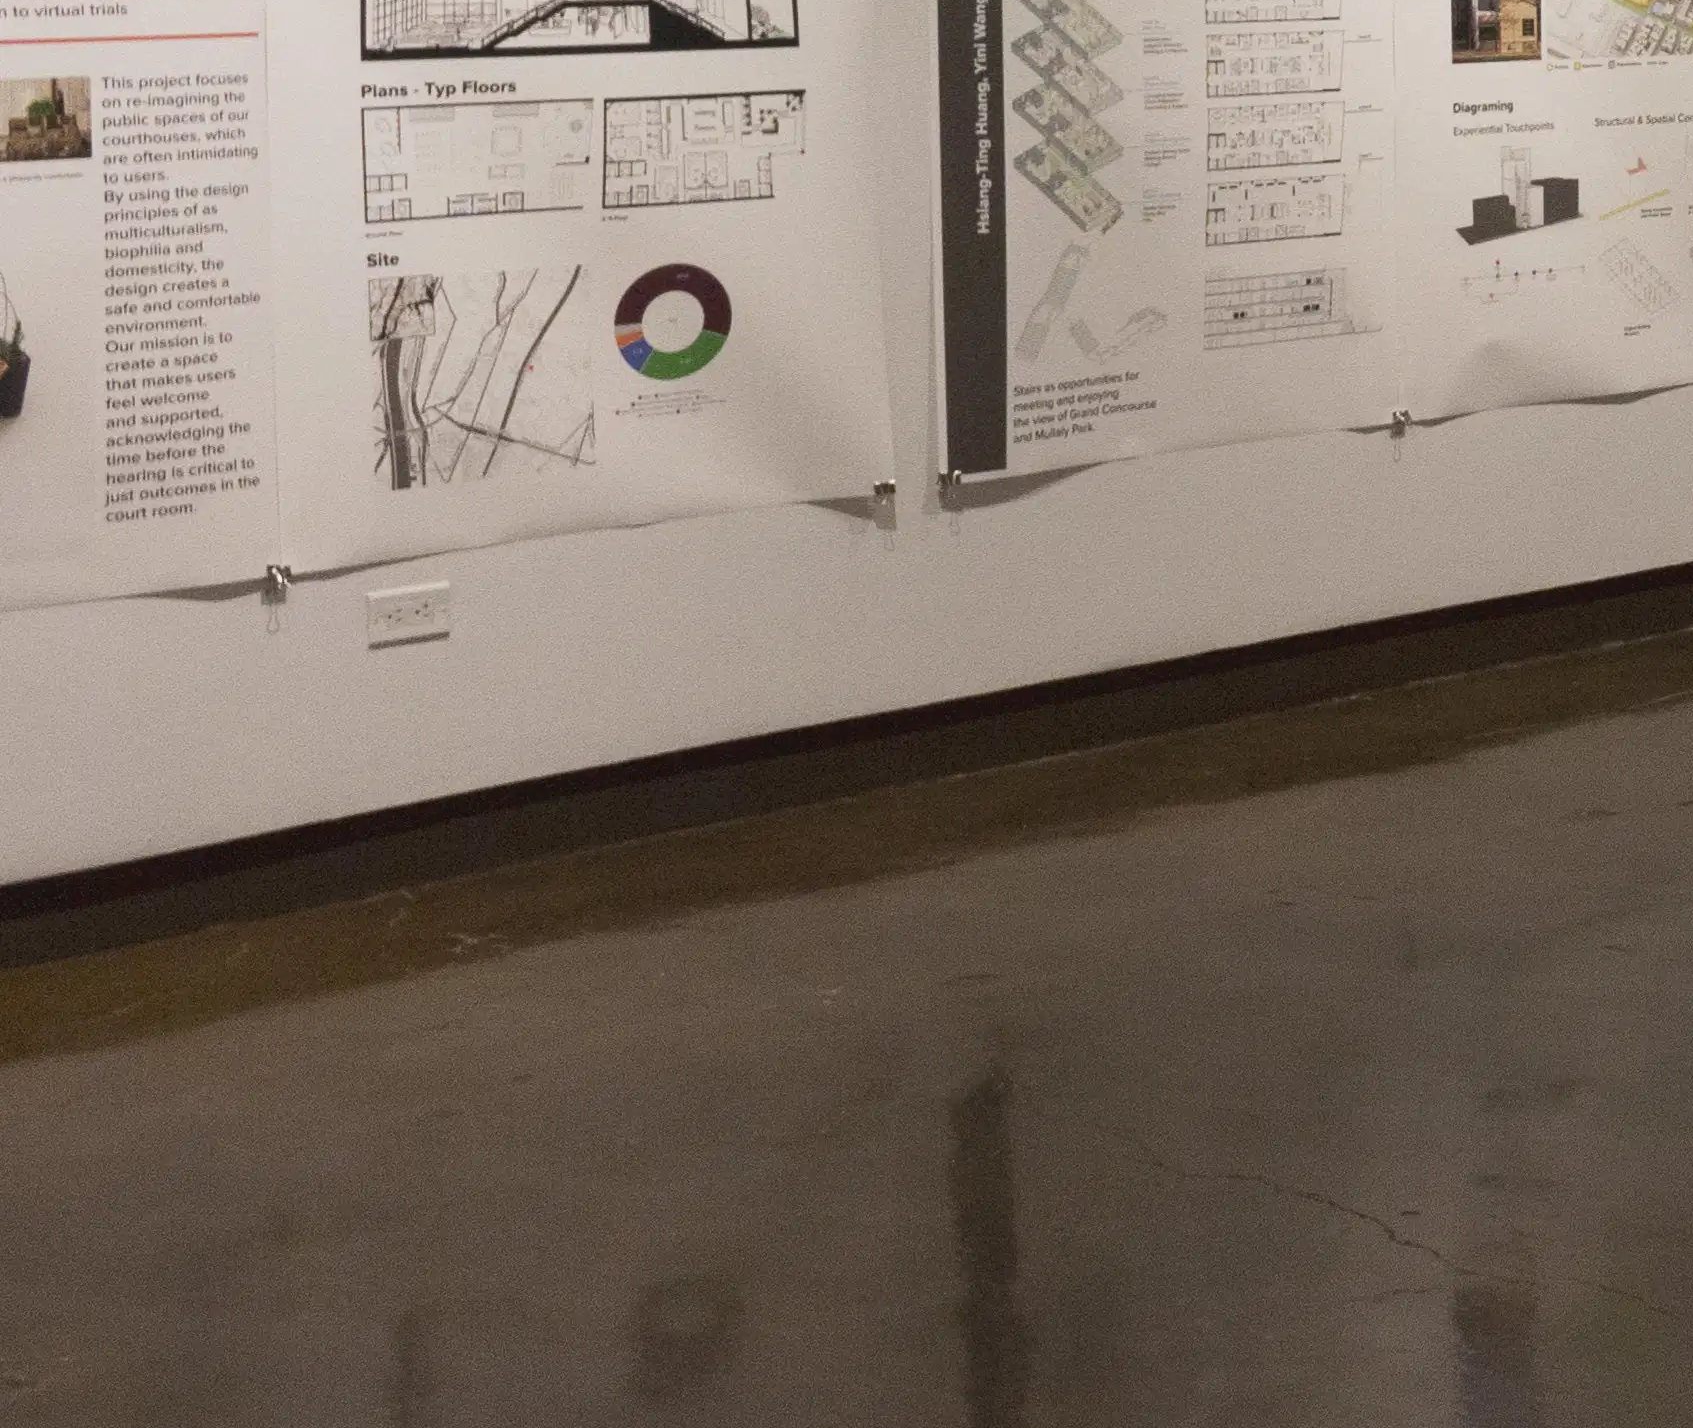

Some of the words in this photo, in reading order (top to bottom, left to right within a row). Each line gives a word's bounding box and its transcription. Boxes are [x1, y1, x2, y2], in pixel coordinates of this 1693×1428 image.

[101, 75, 134, 89] This
[138, 74, 191, 91] project
[194, 73, 248, 86] focuses
[360, 84, 408, 98] Plans
[424, 81, 457, 98] Typ
[461, 80, 516, 94] Floors
[1452, 101, 1514, 115] Diagraming
[366, 252, 399, 267] Site
